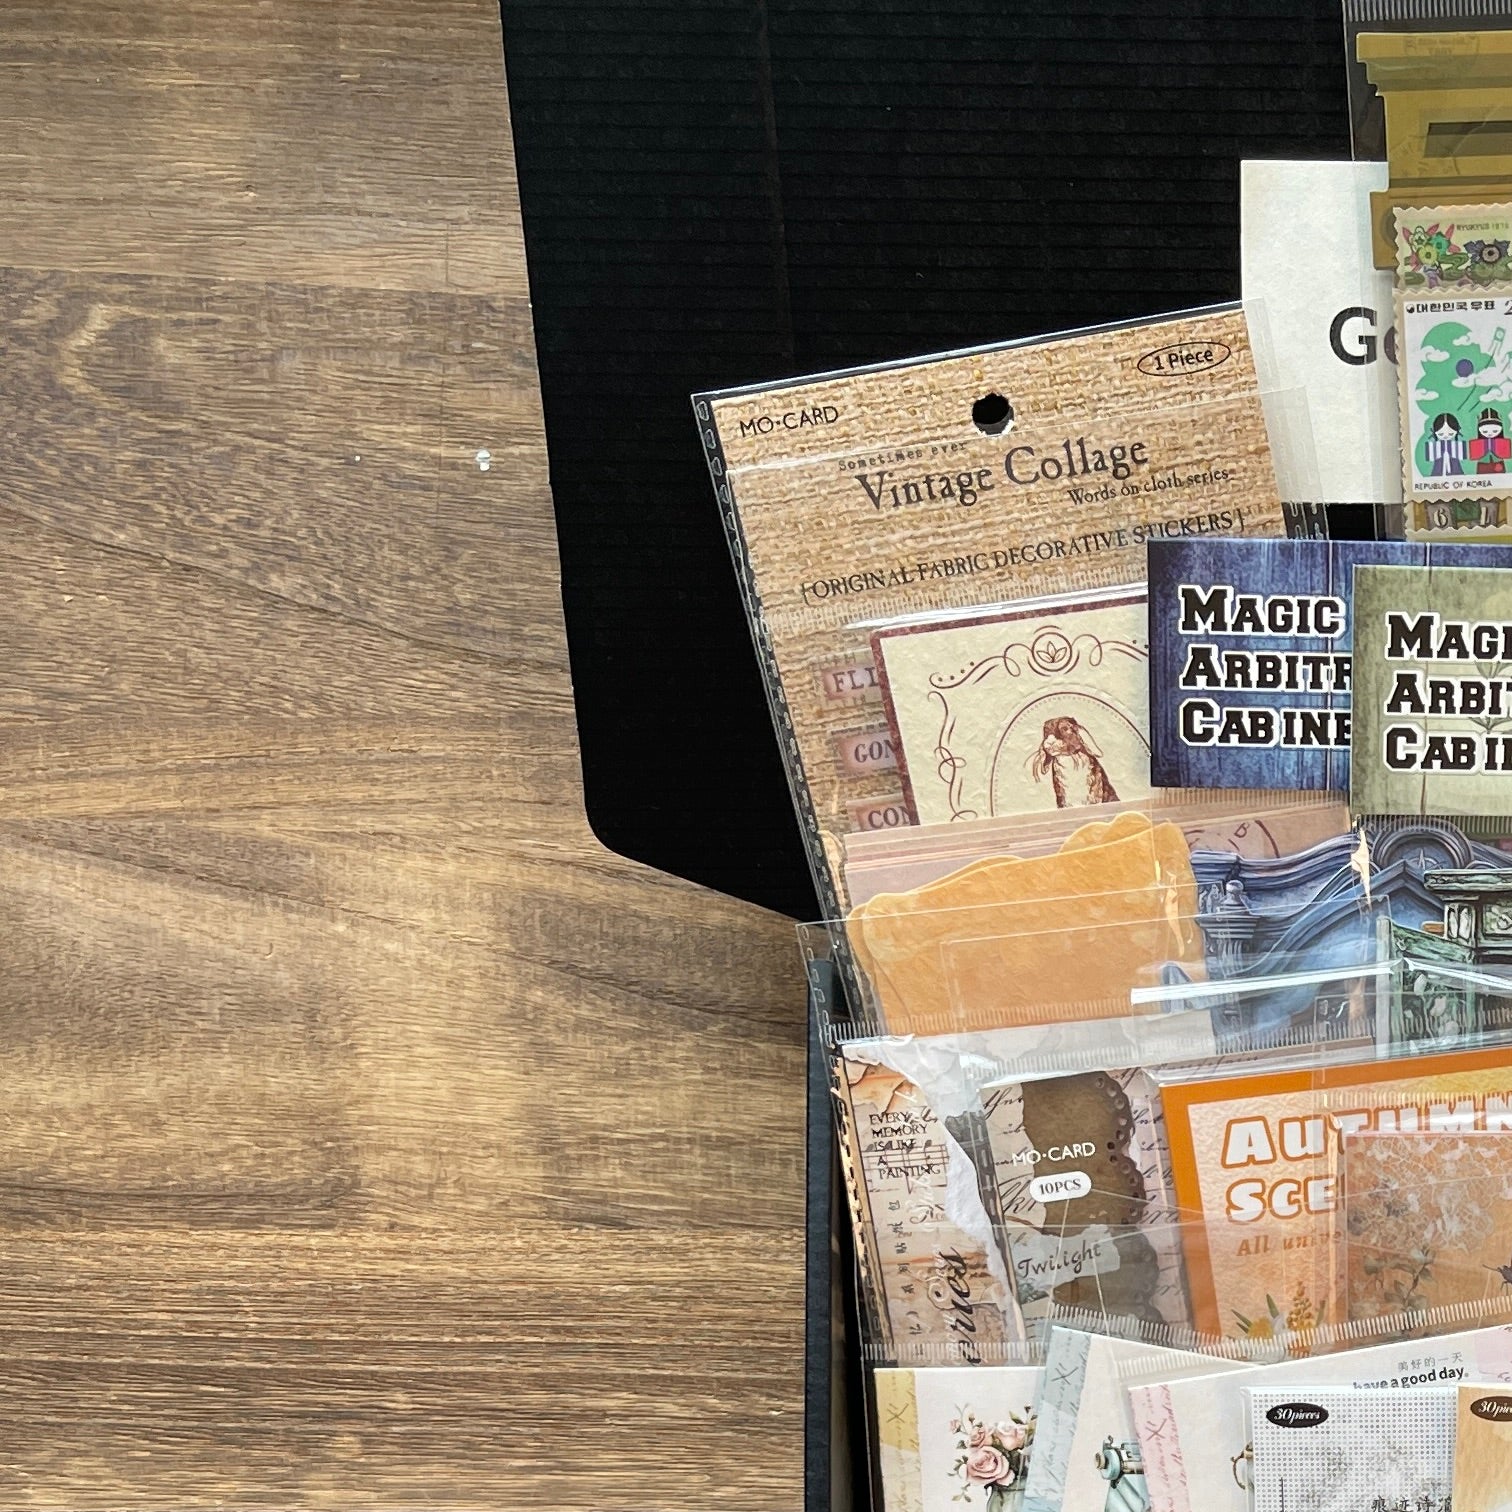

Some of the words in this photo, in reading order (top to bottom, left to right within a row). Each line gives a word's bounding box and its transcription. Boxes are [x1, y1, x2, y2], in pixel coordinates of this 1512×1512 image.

[1416, 301, 1468, 313] 대한민국
[1470, 300, 1496, 312] 우표
[1153, 356, 1163, 371] 1
[1167, 347, 1214, 368] Piece
[838, 449, 923, 472] Sometimes
[855, 466, 995, 513] Vintage
[1004, 436, 1150, 487] Collage
[1414, 480, 1450, 491] REPUBLIC
[1452, 480, 1464, 490] OF
[1466, 479, 1494, 489] KOREA
[1067, 486, 1117, 507] Words
[1121, 484, 1139, 496] on
[1142, 472, 1183, 494] cloth
[1185, 467, 1231, 487] series
[917, 553, 989, 584] FABRIC
[994, 530, 1129, 571] DECORATIVE
[1179, 584, 1347, 639] MAGIC
[871, 1124, 929, 1139] MEMORY
[877, 1155, 888, 1166] A
[878, 1163, 941, 1180] PAINTING
[1037, 1177, 1082, 1198] 10PCS
[1236, 1234, 1272, 1258] All
[1390, 1378, 1400, 1389] a
[1401, 1368, 1437, 1389] good
